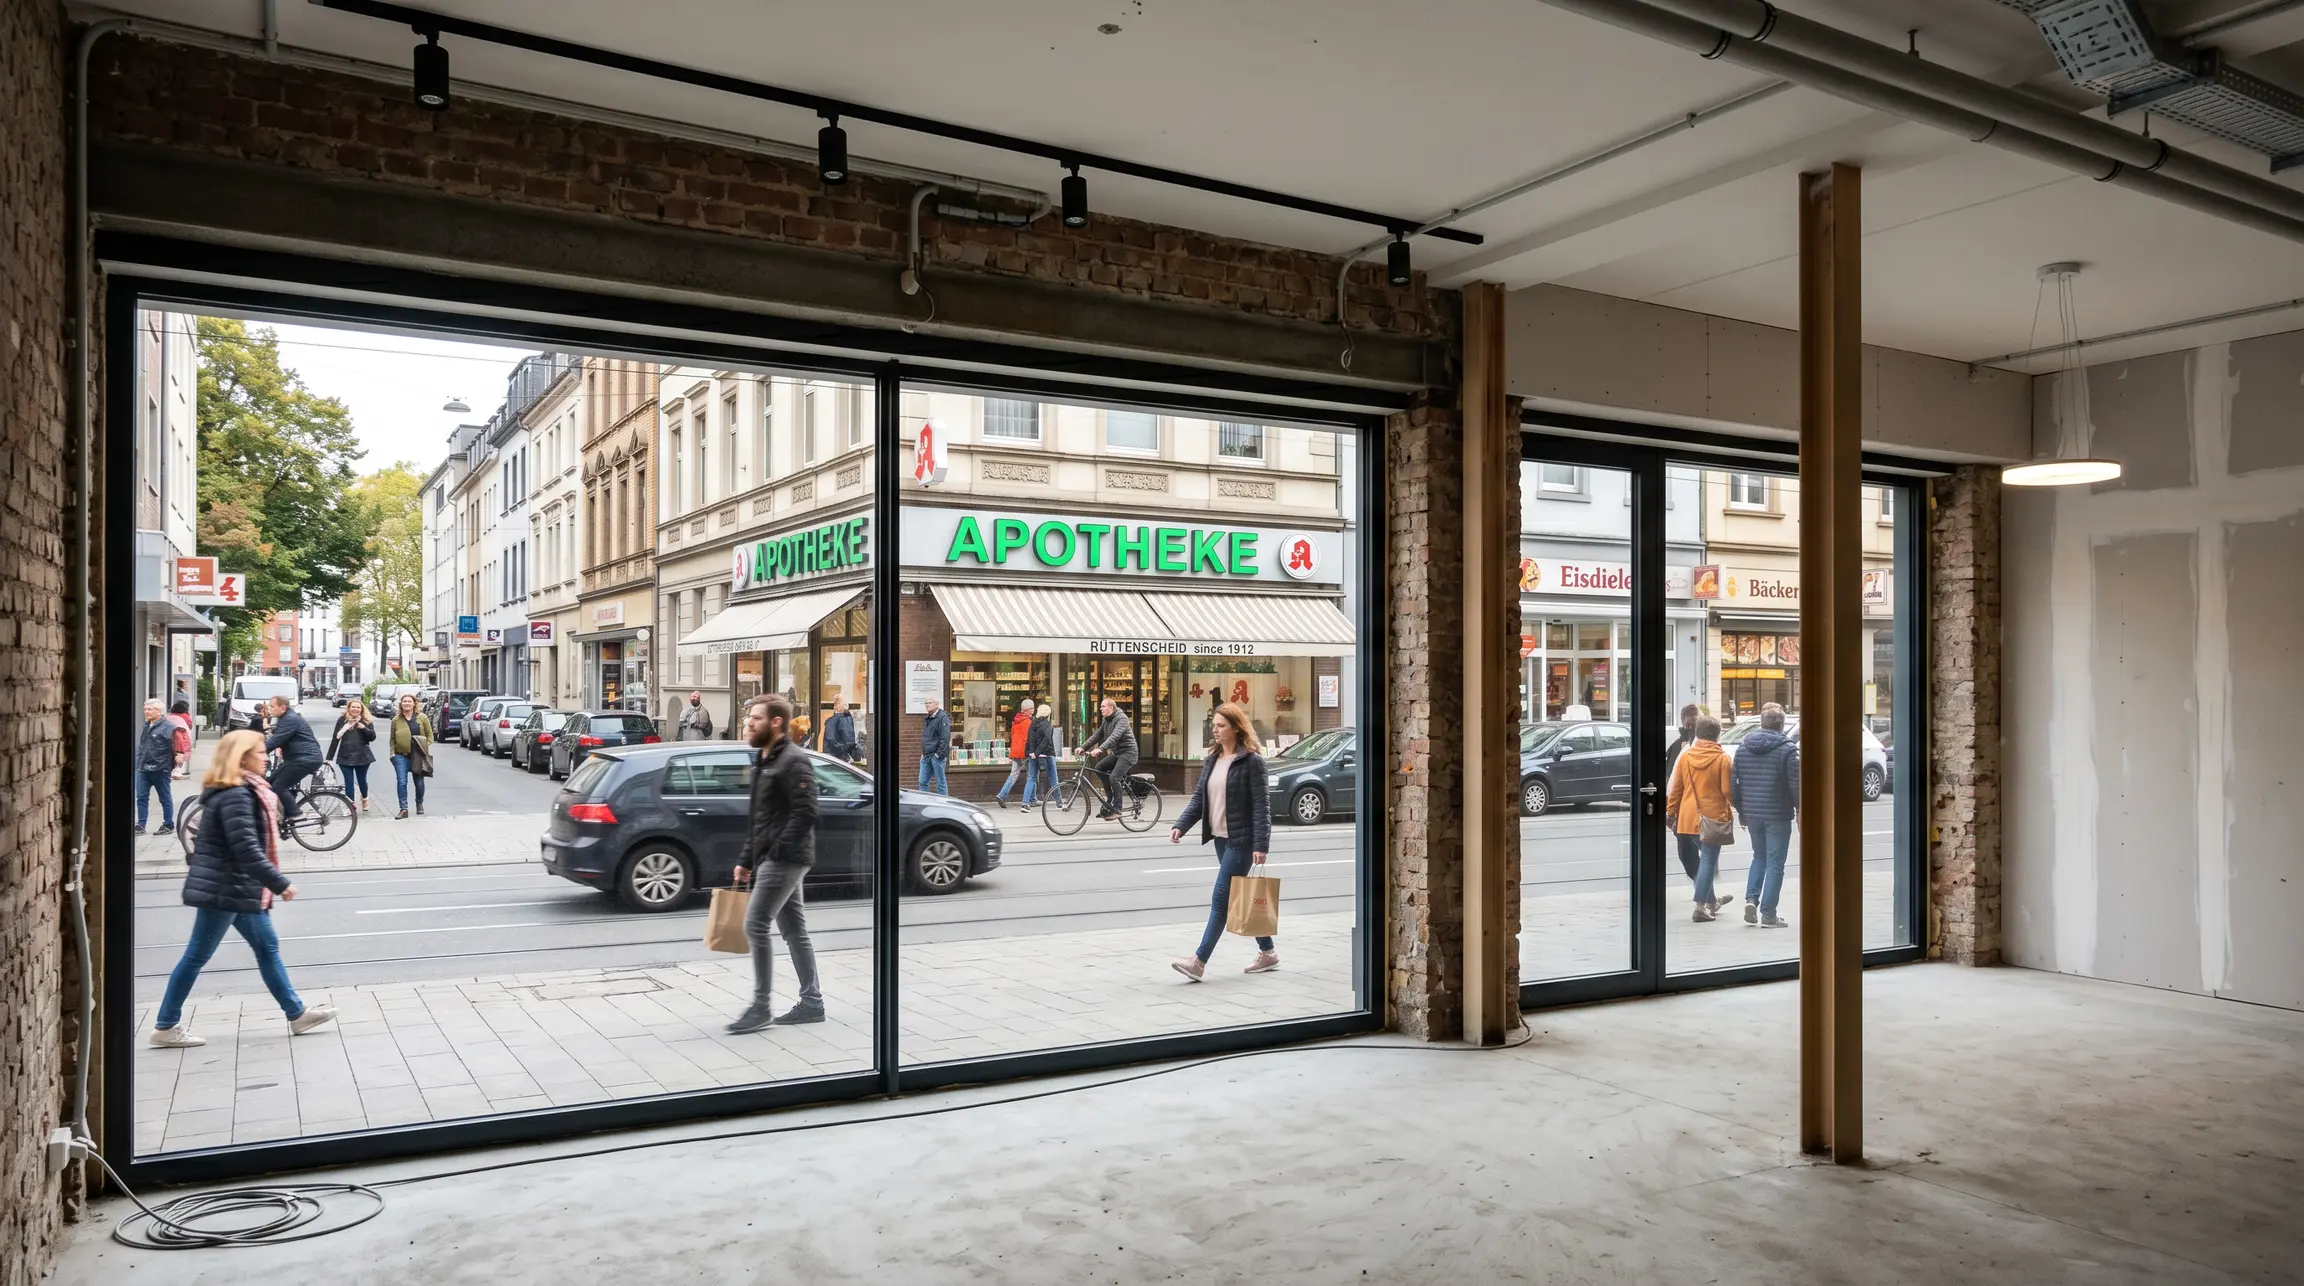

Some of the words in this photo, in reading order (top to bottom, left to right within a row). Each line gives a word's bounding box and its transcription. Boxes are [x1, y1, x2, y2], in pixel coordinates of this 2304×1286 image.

[754, 517, 869, 581] APOTHEKE
[945, 516, 1259, 575] APOTHEKE
[1090, 640, 1187, 653] RÜTTENSCHEID
[1194, 644, 1223, 654] since
[1228, 644, 1254, 654] 1912
